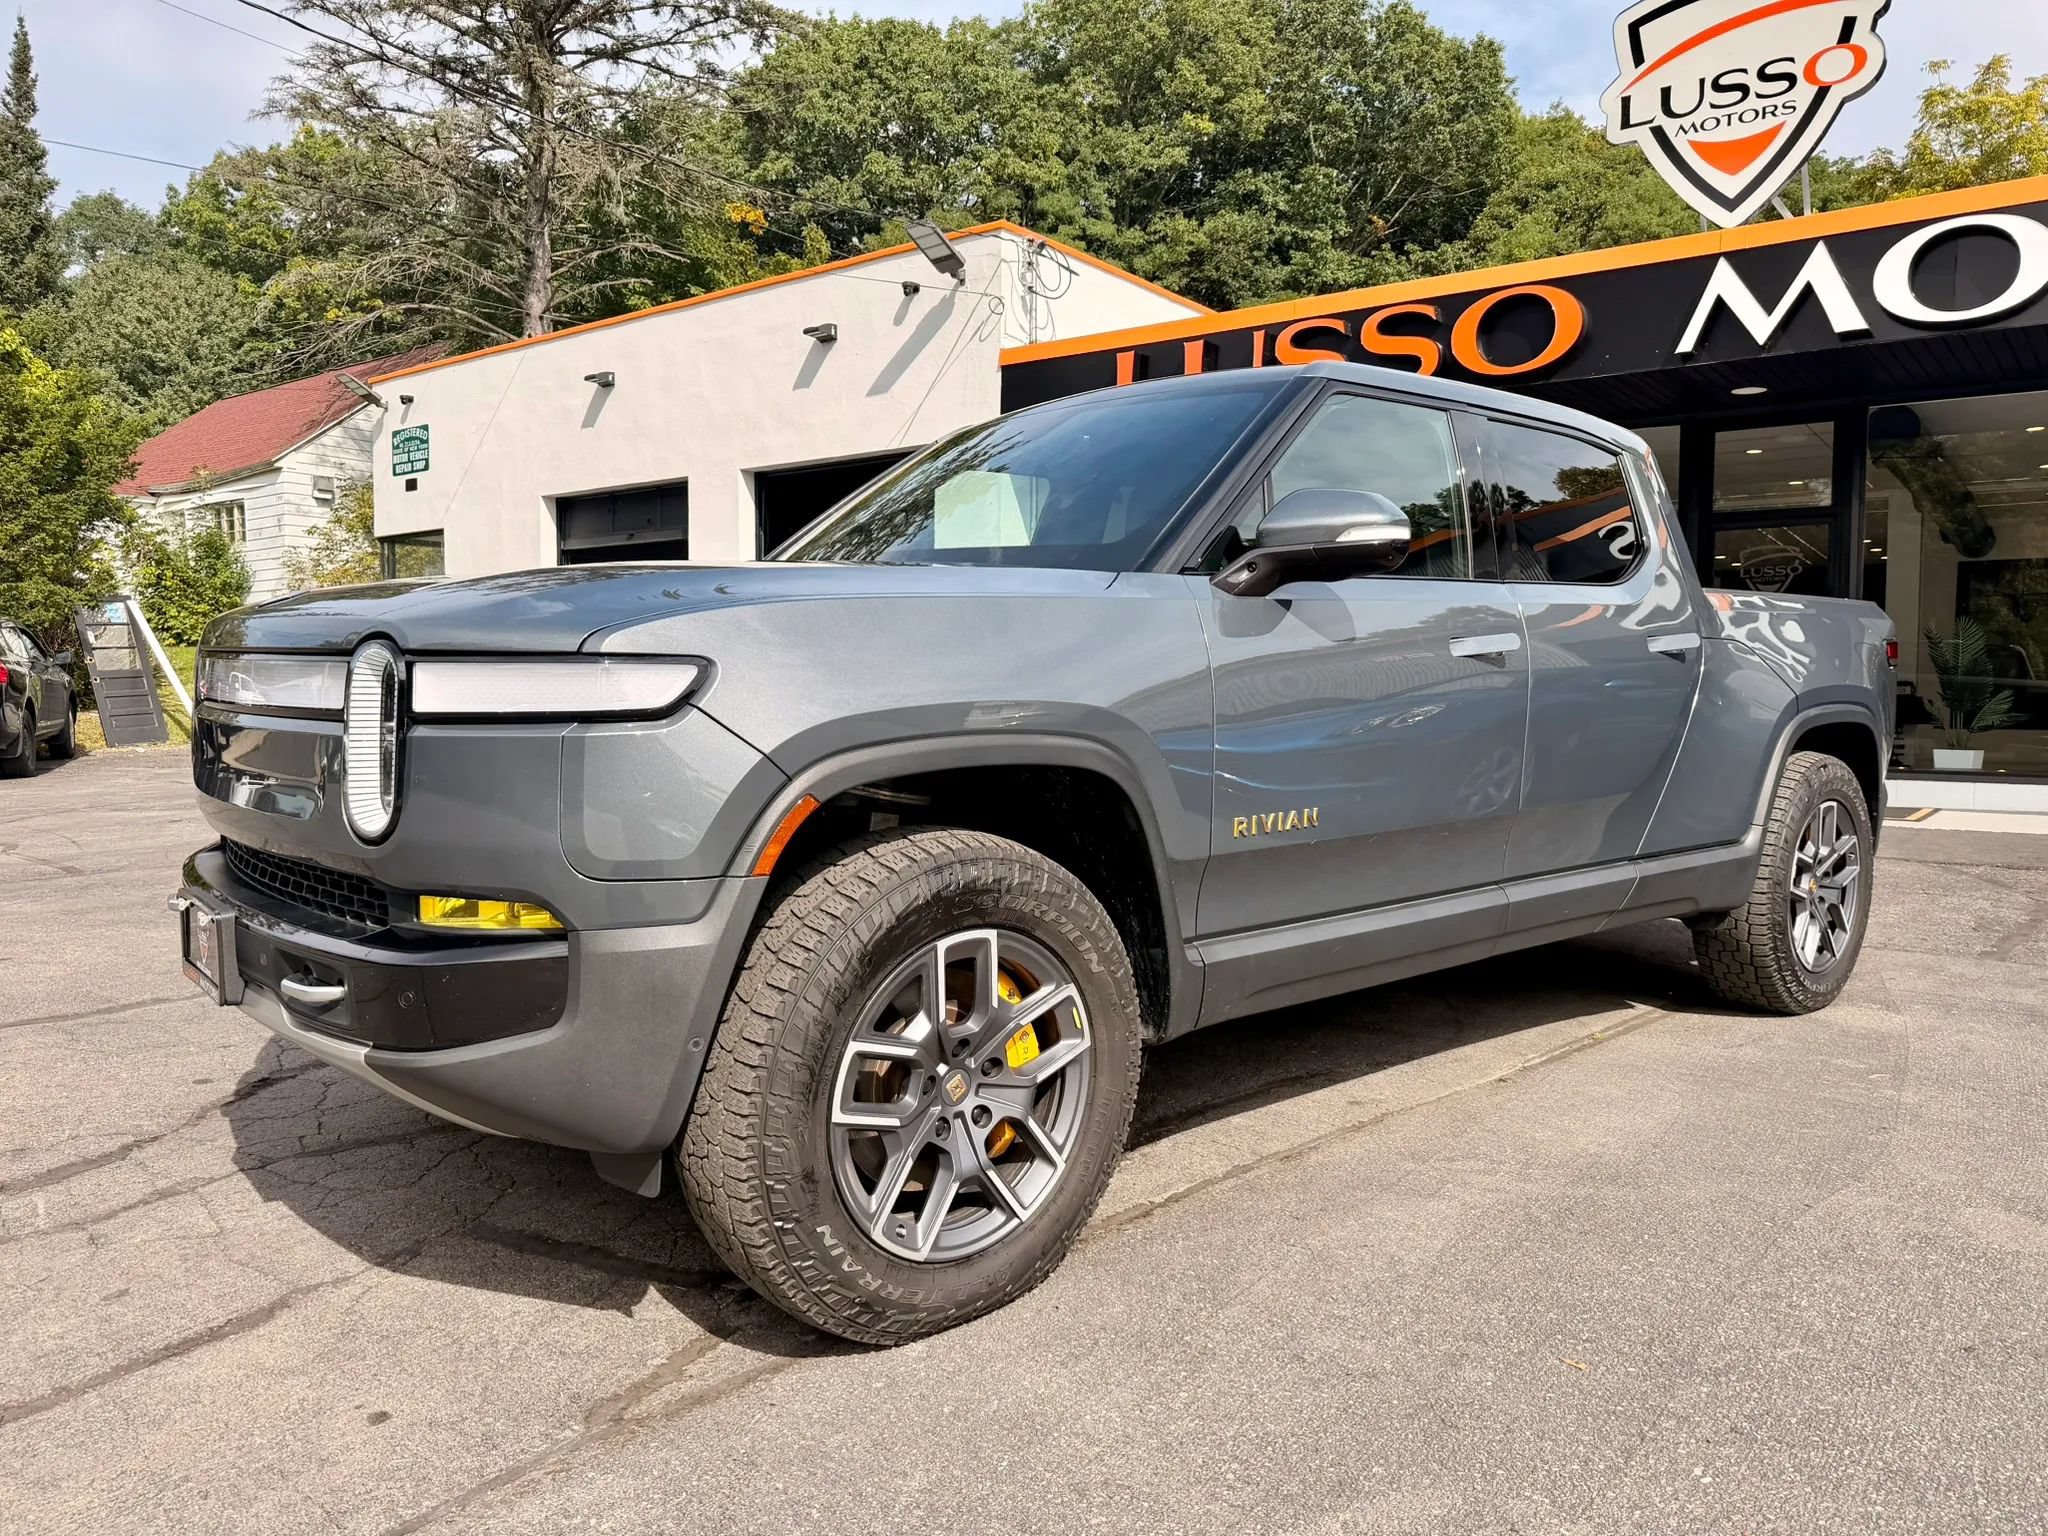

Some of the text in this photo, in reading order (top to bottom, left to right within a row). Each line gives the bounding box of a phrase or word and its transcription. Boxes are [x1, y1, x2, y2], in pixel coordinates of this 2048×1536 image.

[1620, 43, 1868, 131] LUSSO
[1674, 99, 1797, 138] MOTORS
[1673, 213, 2048, 354] MO
[393, 428, 428, 446] REGISTERED
[395, 460, 425, 474] REPAIR SHOP
[409, 450, 428, 461] VEHICLE
[1740, 564, 1803, 578] LUSSO
[1233, 807, 1319, 839] RIVIAN
[952, 892, 1106, 975] SCORPION
[815, 1224, 956, 1309] TERRAIN
